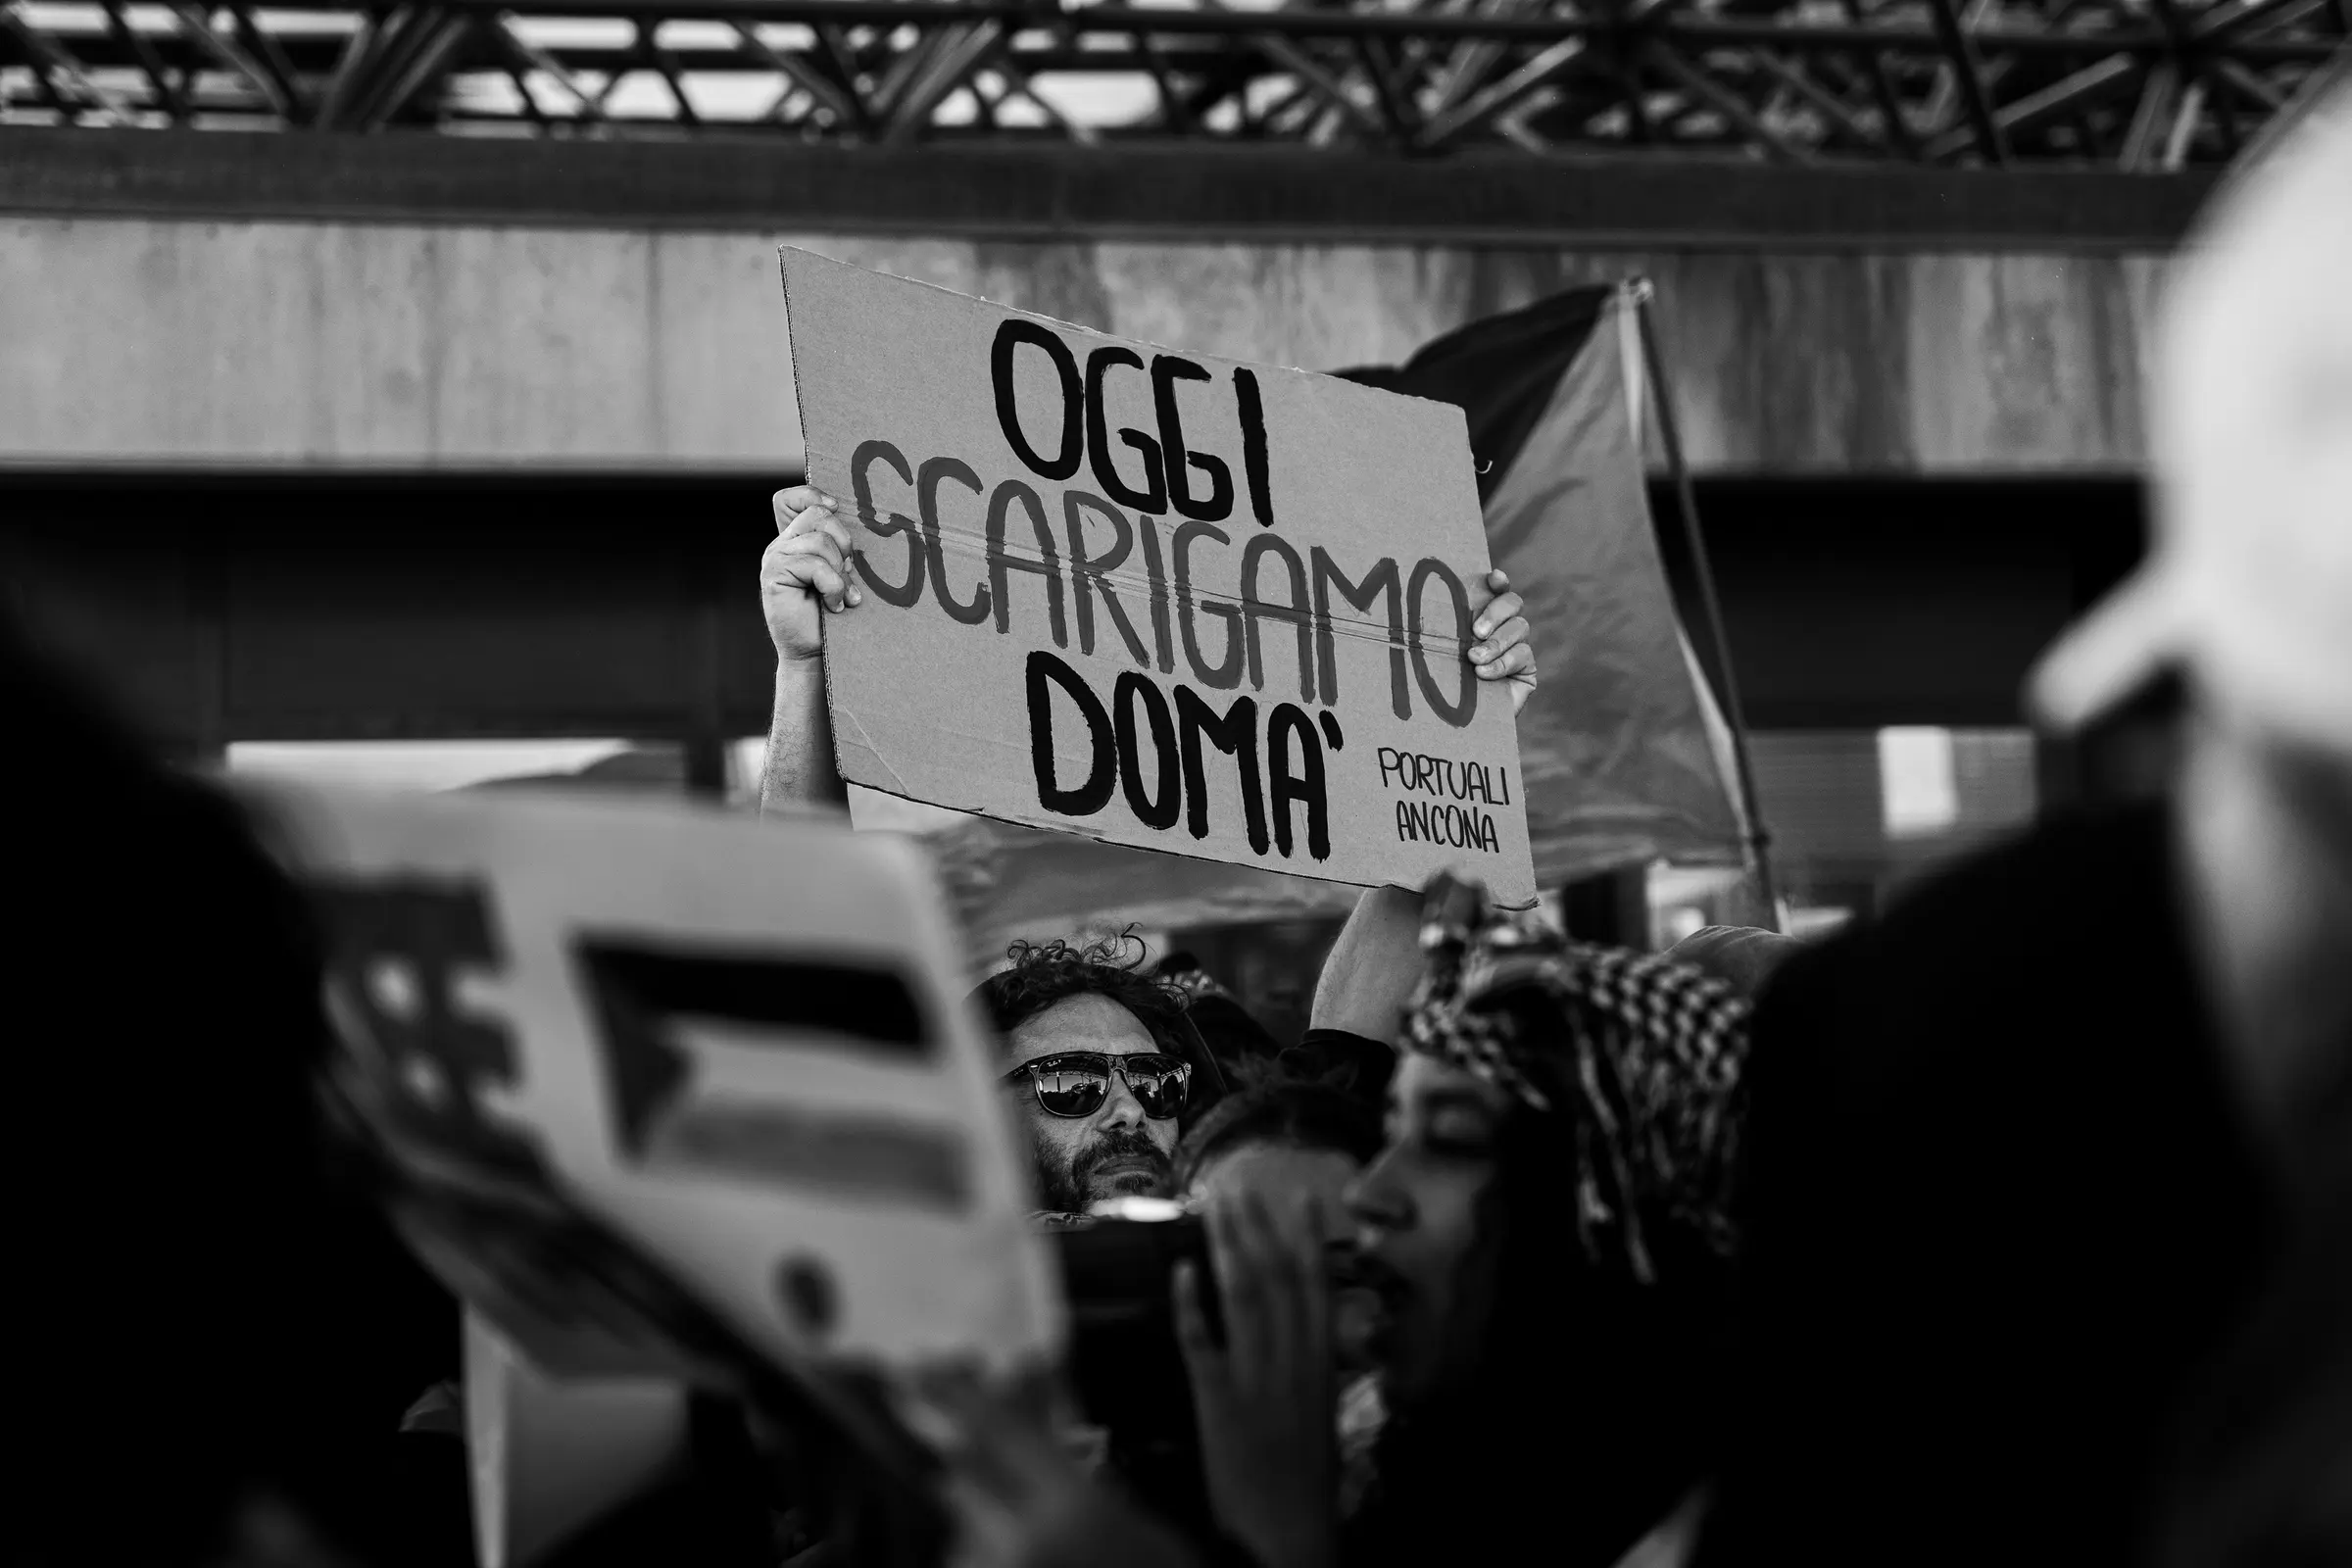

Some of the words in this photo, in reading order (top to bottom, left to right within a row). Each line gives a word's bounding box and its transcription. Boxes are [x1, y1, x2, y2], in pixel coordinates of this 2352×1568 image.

[991, 318, 1273, 527] OGGI
[851, 440, 1480, 728] SCARIGAMO
[1378, 747, 1509, 805] PORTUALI
[1396, 800, 1499, 854] ANCONA
